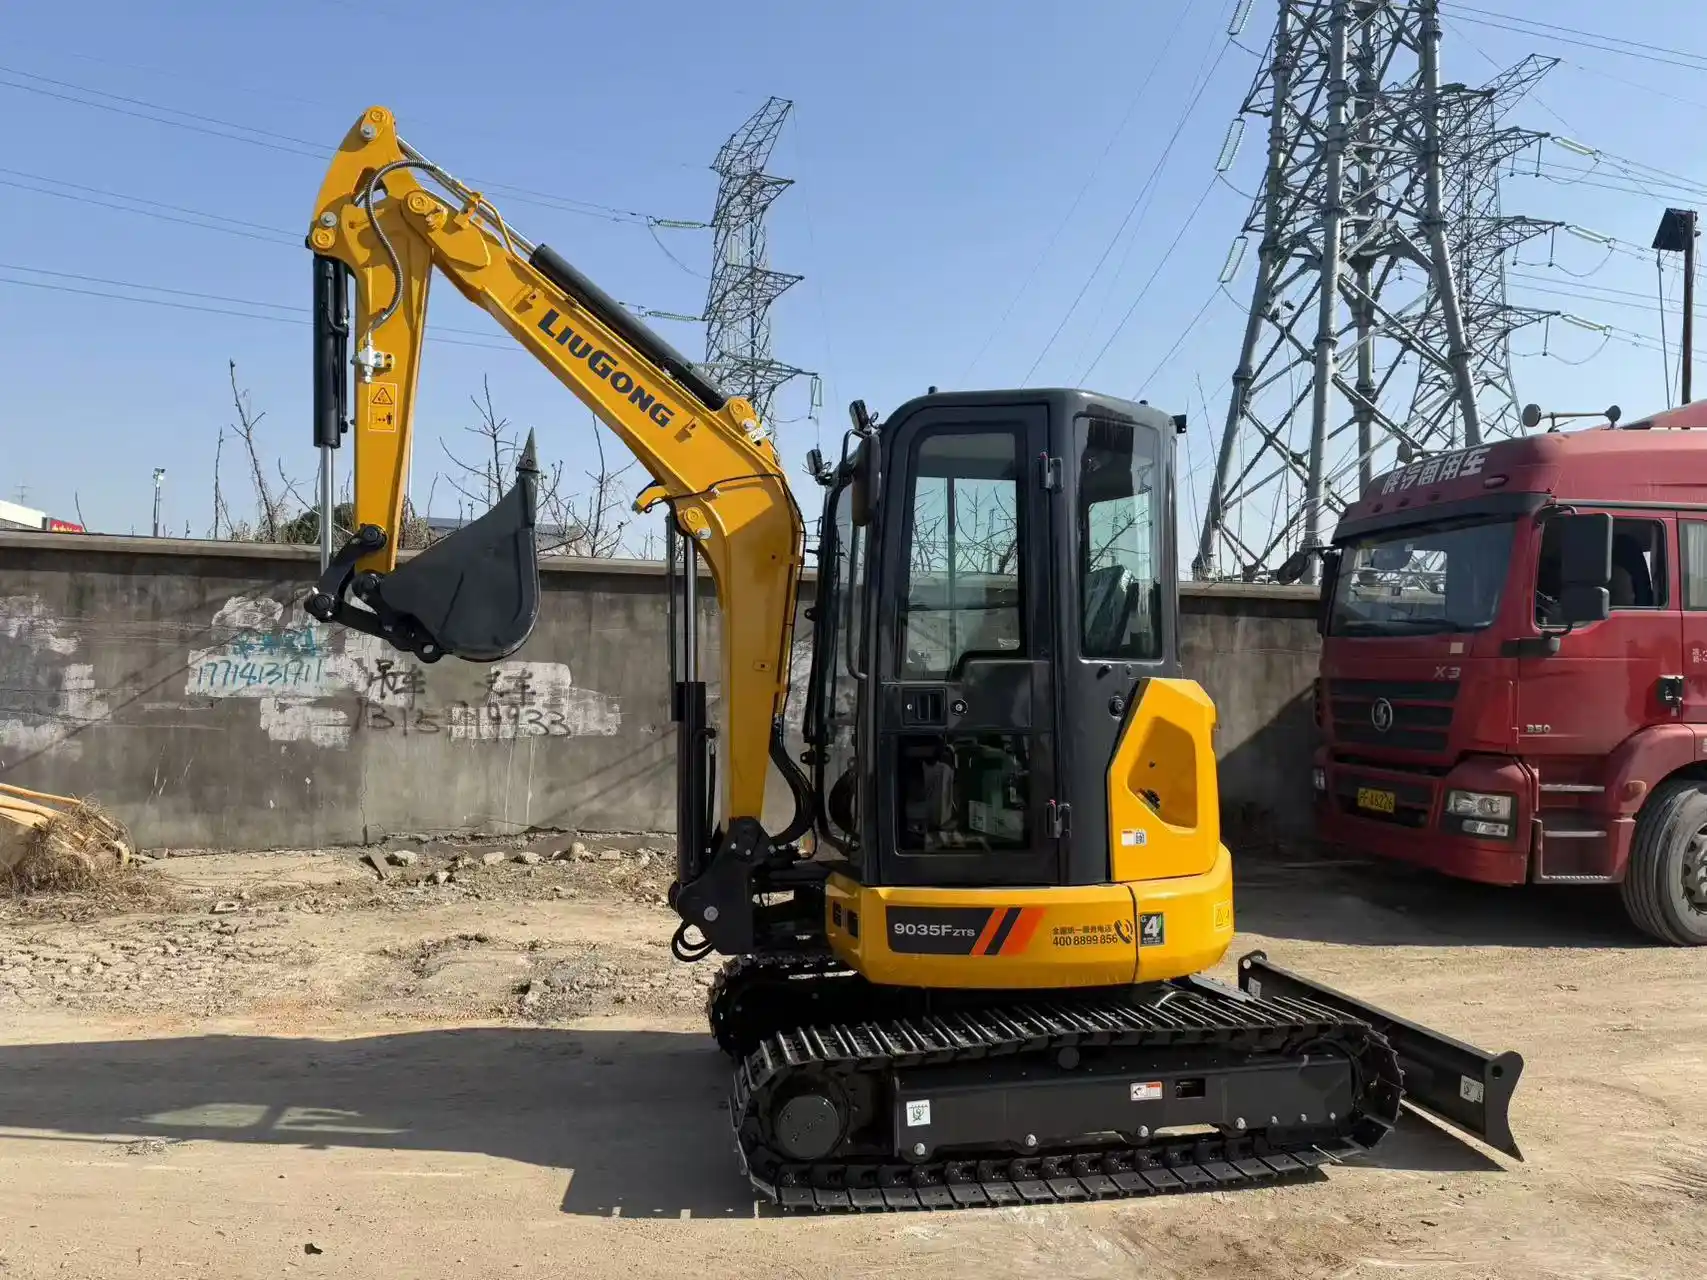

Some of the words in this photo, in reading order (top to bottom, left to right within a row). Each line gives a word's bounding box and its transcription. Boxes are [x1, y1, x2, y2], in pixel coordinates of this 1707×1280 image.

[537, 308, 675, 428] LIUGONG
[1144, 915, 1160, 938] 4
[1053, 935, 1072, 946] 400
